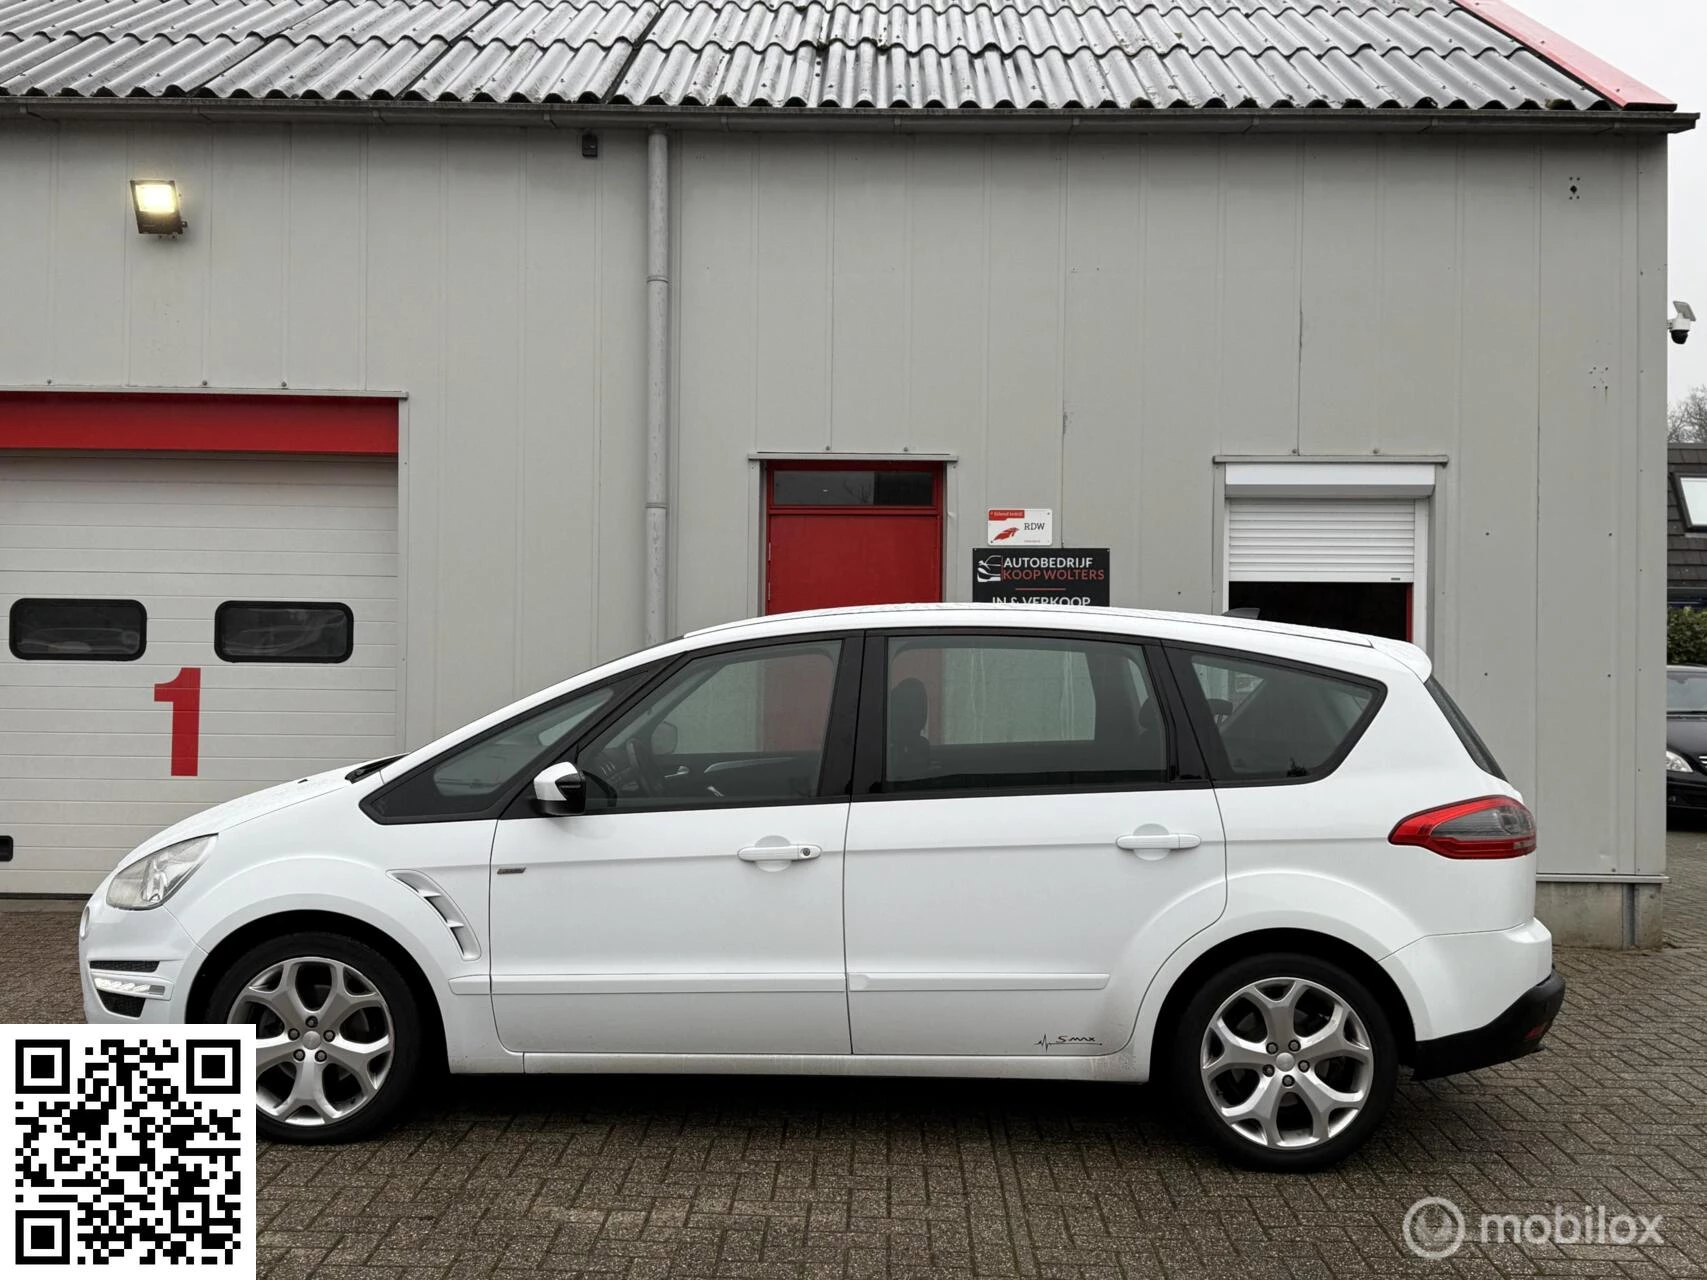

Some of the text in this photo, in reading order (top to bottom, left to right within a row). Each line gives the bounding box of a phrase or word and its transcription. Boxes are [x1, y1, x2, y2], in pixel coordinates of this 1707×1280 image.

[1024, 522, 1045, 531] RDW
[1003, 557, 1093, 568] AUTOBEDRIJF
[1003, 569, 1105, 580] KOOP WOLTERS
[154, 667, 201, 776] 1
